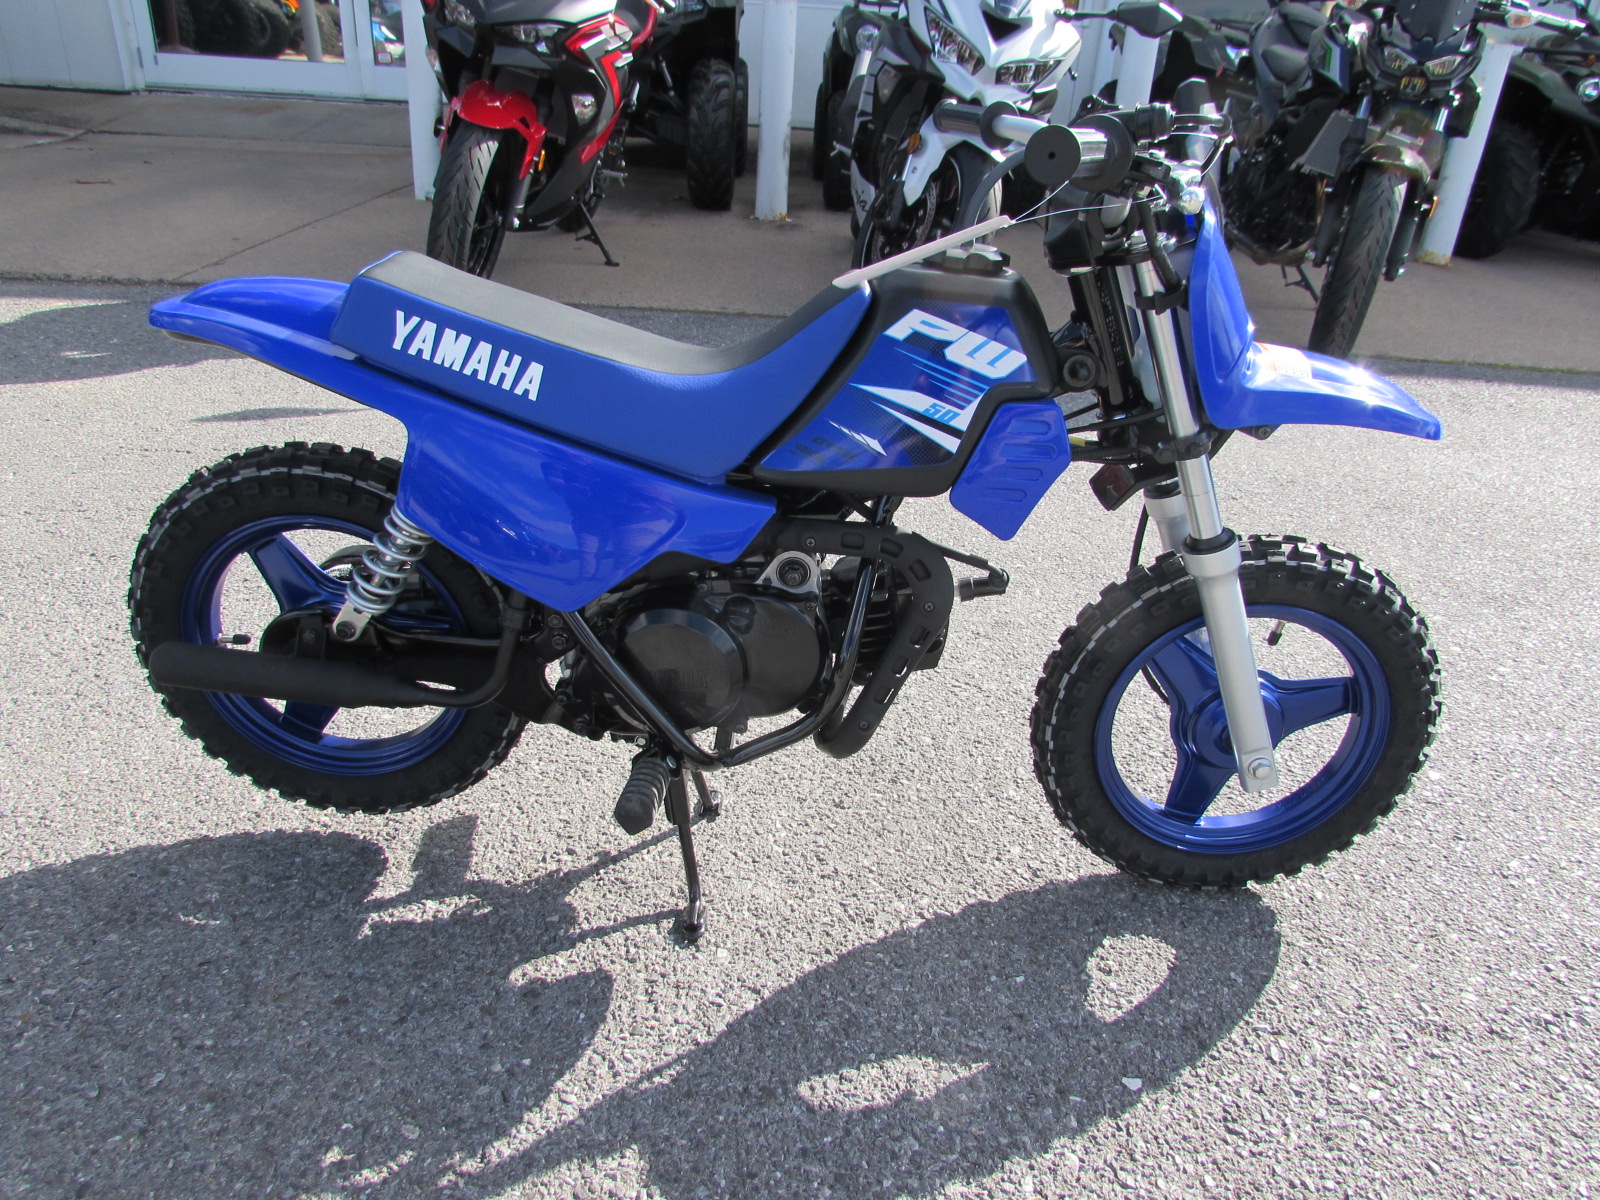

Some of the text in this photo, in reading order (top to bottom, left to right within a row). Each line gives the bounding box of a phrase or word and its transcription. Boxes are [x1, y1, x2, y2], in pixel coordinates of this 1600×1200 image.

[392, 310, 544, 402] YAMAHA
[882, 308, 1028, 379] PW
[921, 402, 961, 425] 50
